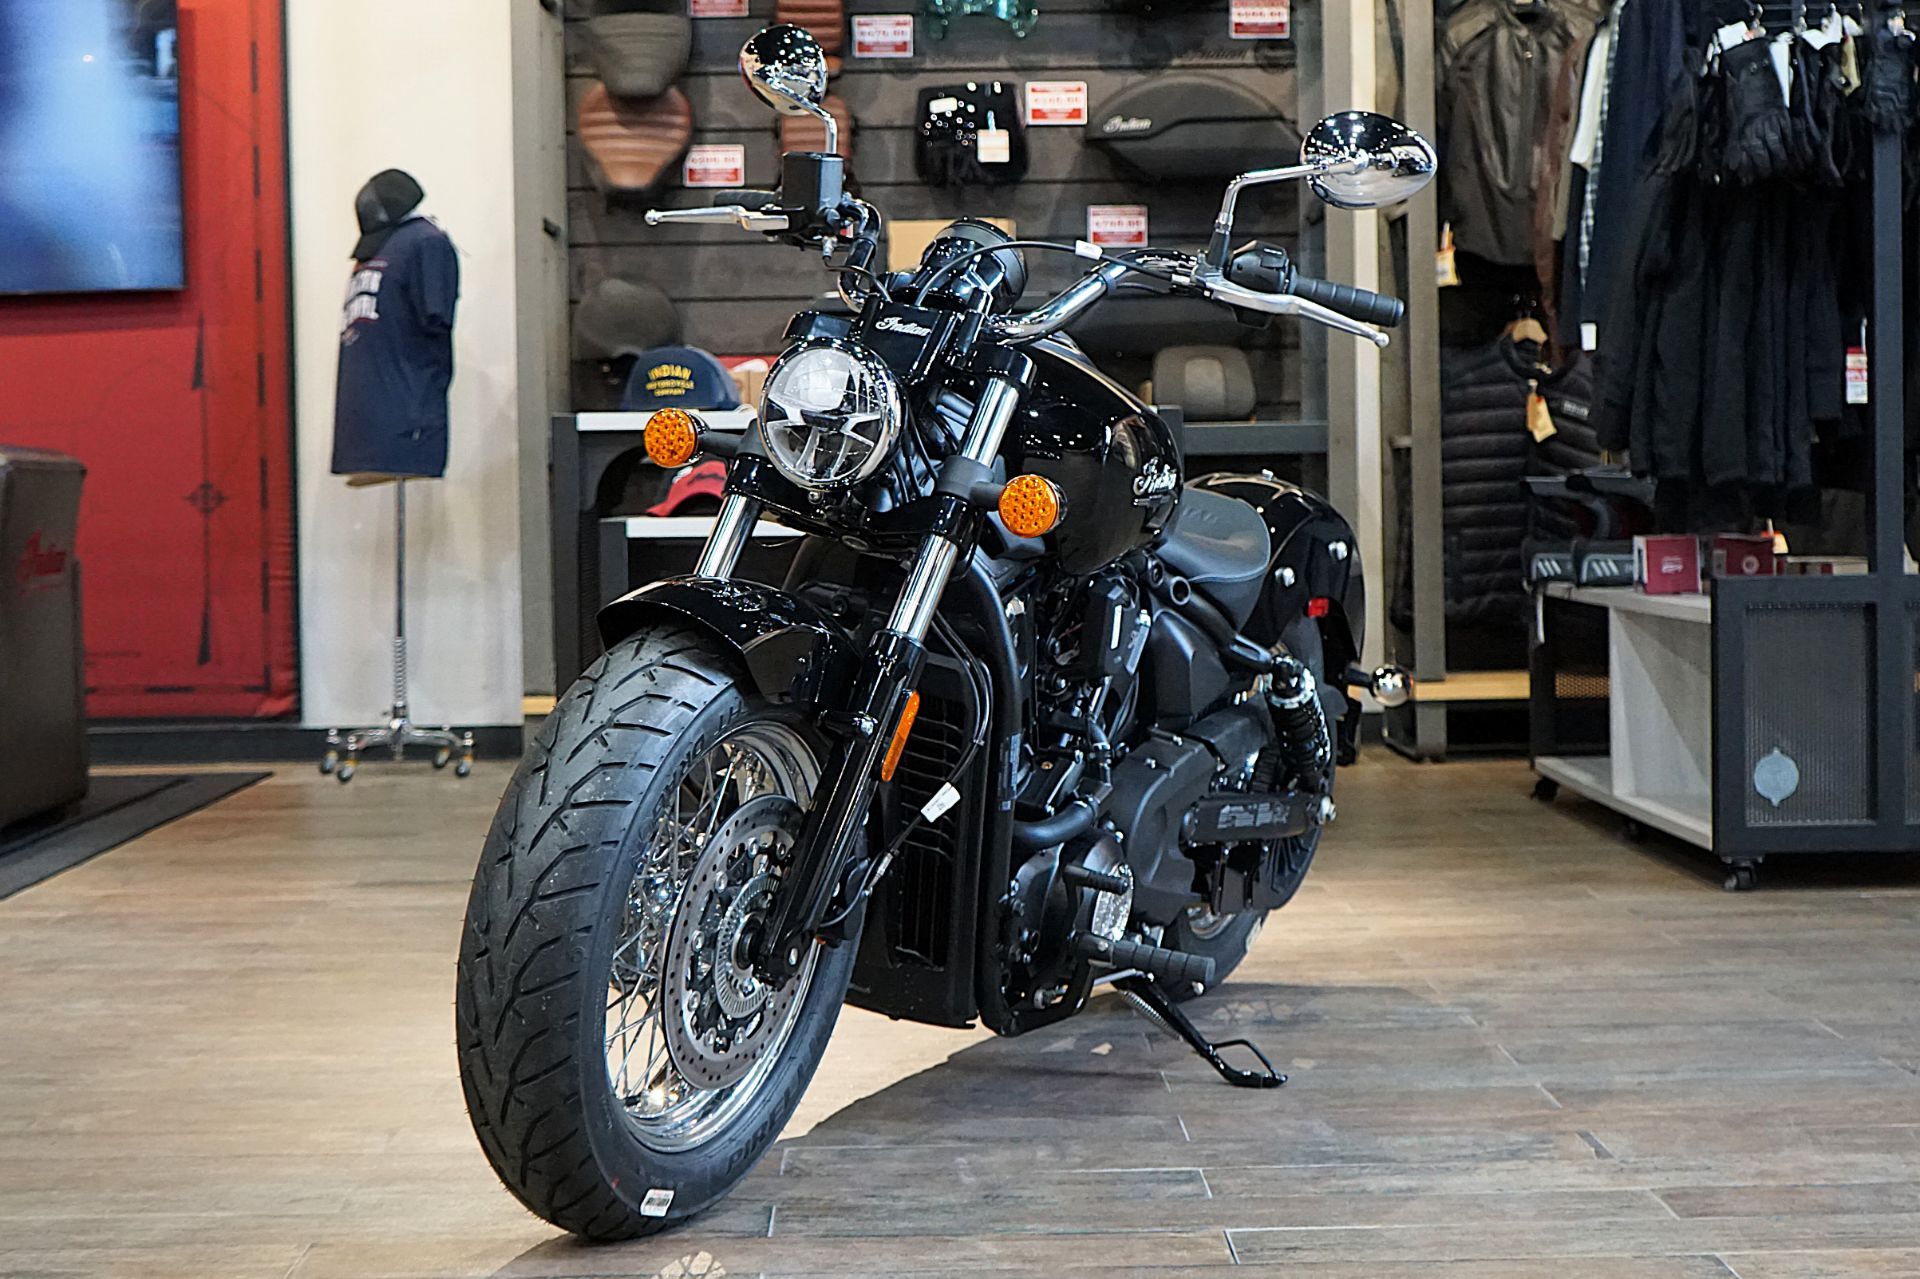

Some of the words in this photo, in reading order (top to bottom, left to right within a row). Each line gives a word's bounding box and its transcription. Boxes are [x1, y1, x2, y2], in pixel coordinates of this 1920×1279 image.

[1103, 115, 1152, 133] Indian
[875, 316, 932, 336] Indian
[648, 364, 692, 380] INDIAN
